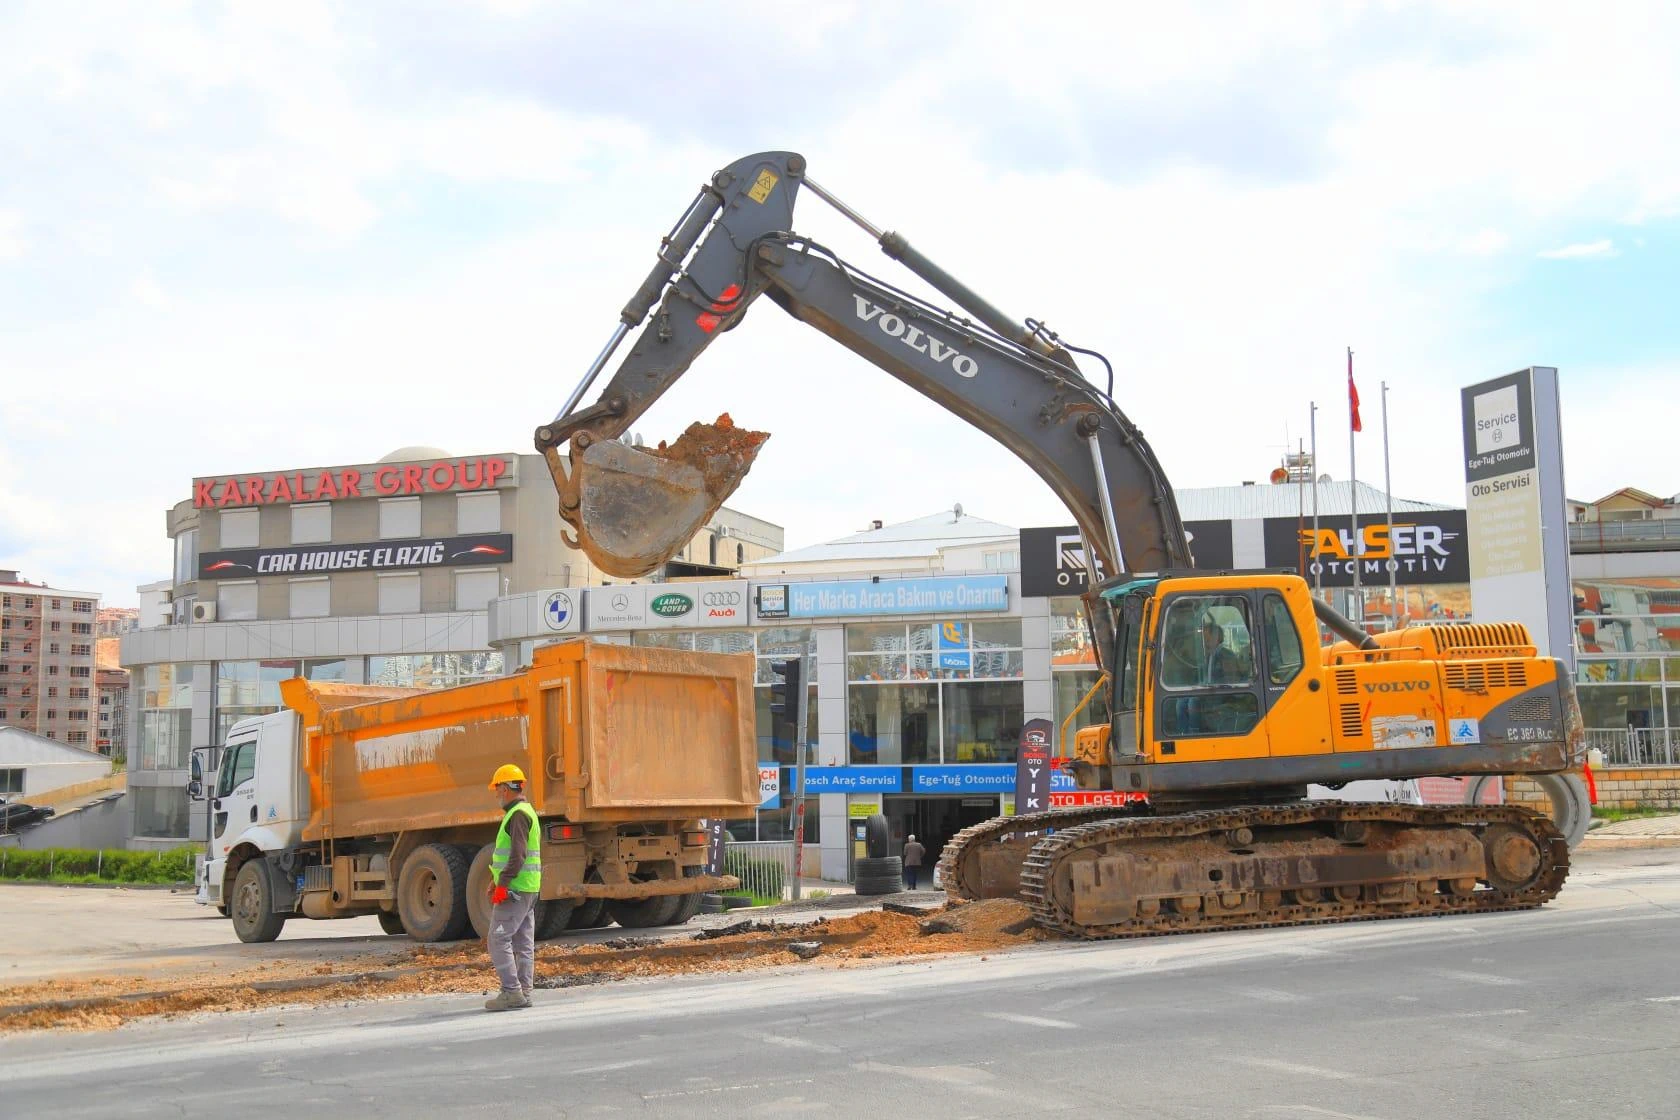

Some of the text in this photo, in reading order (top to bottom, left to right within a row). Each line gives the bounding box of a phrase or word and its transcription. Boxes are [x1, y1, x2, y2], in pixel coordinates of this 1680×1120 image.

[853, 293, 979, 378] VOLVO
[1477, 412, 1517, 431] Service
[1496, 446, 1530, 462] Otomotiv
[194, 457, 506, 508] KARALAR GROUP
[1471, 473, 1530, 497] Oto Servisi
[1298, 523, 1451, 560] AHSER
[257, 541, 445, 573] CAR HOUSE ELAZIĞ
[661, 604, 688, 613] ROVER
[794, 591, 817, 611] Her
[819, 588, 857, 609] Marka
[860, 587, 895, 609] Araca
[939, 591, 953, 606] ve
[708, 609, 736, 617] Audi
[1363, 680, 1431, 694] VOLVO
[832, 775, 856, 787] Araç
[859, 775, 896, 785] Servisi
[919, 774, 1016, 786] Ege-Tuğ Otomotiv
